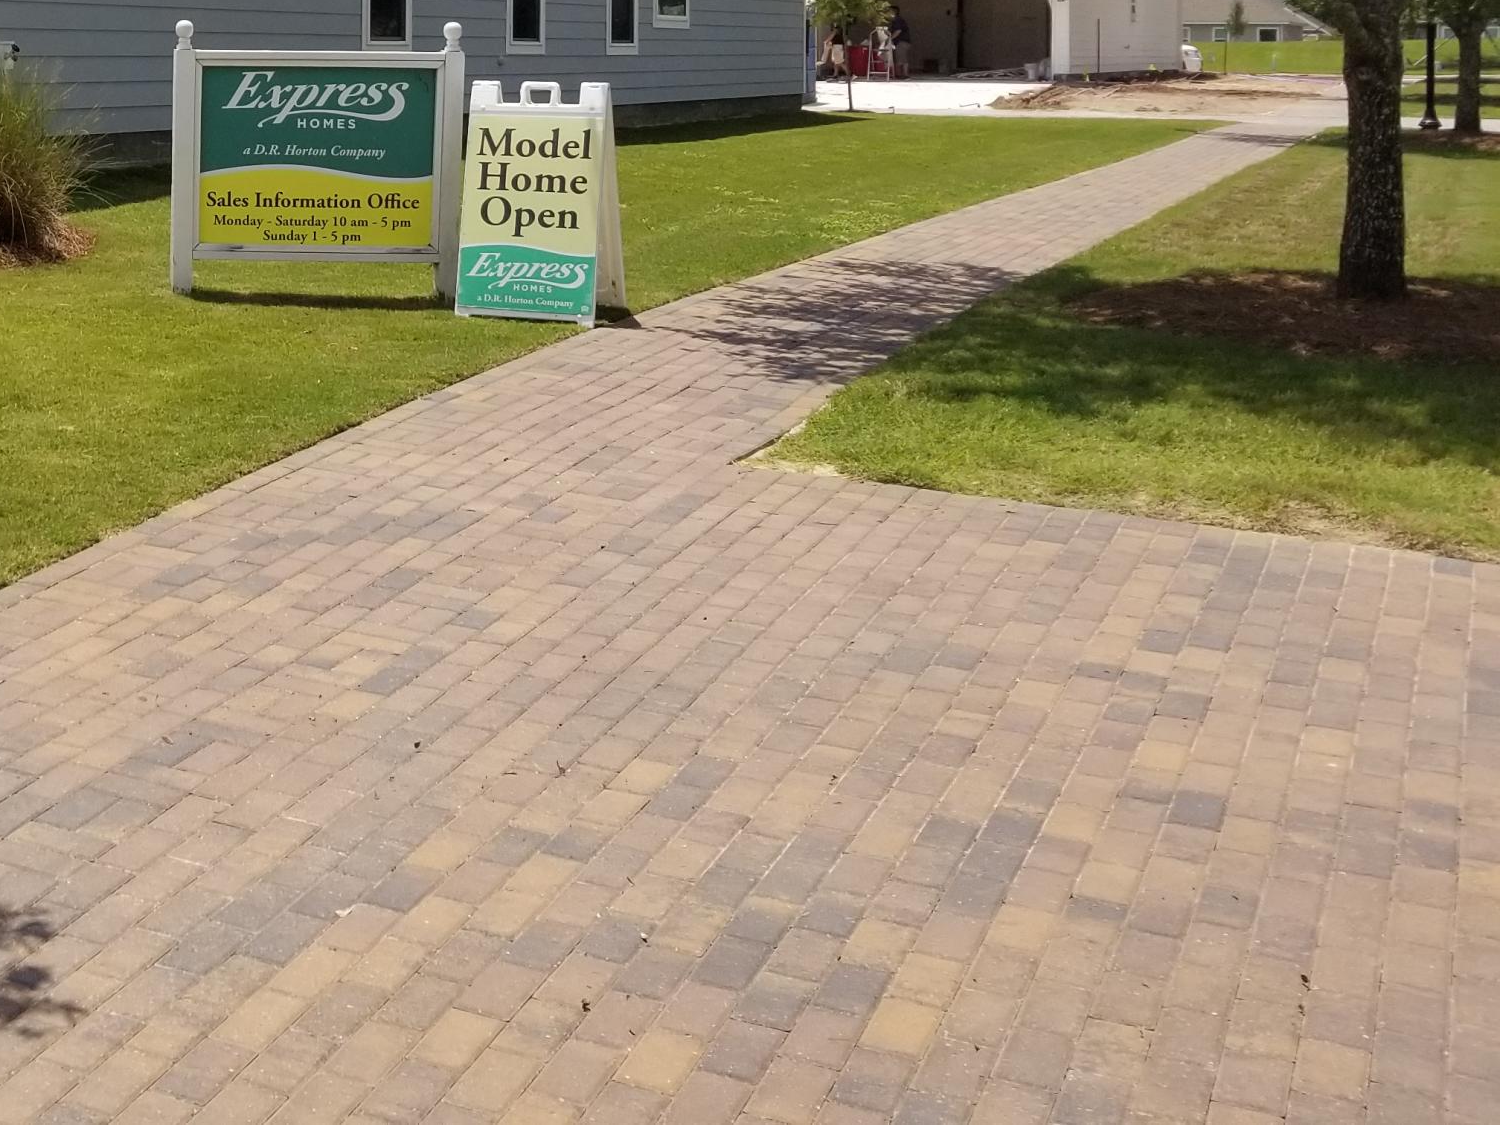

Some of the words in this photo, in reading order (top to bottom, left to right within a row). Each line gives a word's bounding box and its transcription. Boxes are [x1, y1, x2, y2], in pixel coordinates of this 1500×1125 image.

[221, 71, 410, 127] Express
[296, 118, 357, 130] HOMES
[242, 147, 251, 156] a
[253, 144, 282, 156] D.R.
[284, 145, 327, 157] Horton
[330, 145, 387, 160] Company
[476, 127, 593, 160] Model
[476, 161, 588, 195] Home
[205, 190, 250, 208] Sales
[254, 191, 362, 210] Information
[366, 192, 421, 210] Office
[213, 214, 264, 229] Monday
[275, 214, 329, 230] Saturday
[332, 216, 347, 227] 10
[350, 218, 369, 228] am
[380, 216, 388, 228] 5
[391, 219, 412, 231] pm
[480, 196, 581, 238] Open
[262, 229, 308, 244] Sunday
[311, 231, 318, 241] 1
[330, 231, 338, 242] 5
[341, 233, 362, 245] pm
[465, 252, 589, 290] Express
[512, 283, 553, 294] HOMES
[504, 294, 534, 305] Horton
[535, 297, 574, 309] Company
